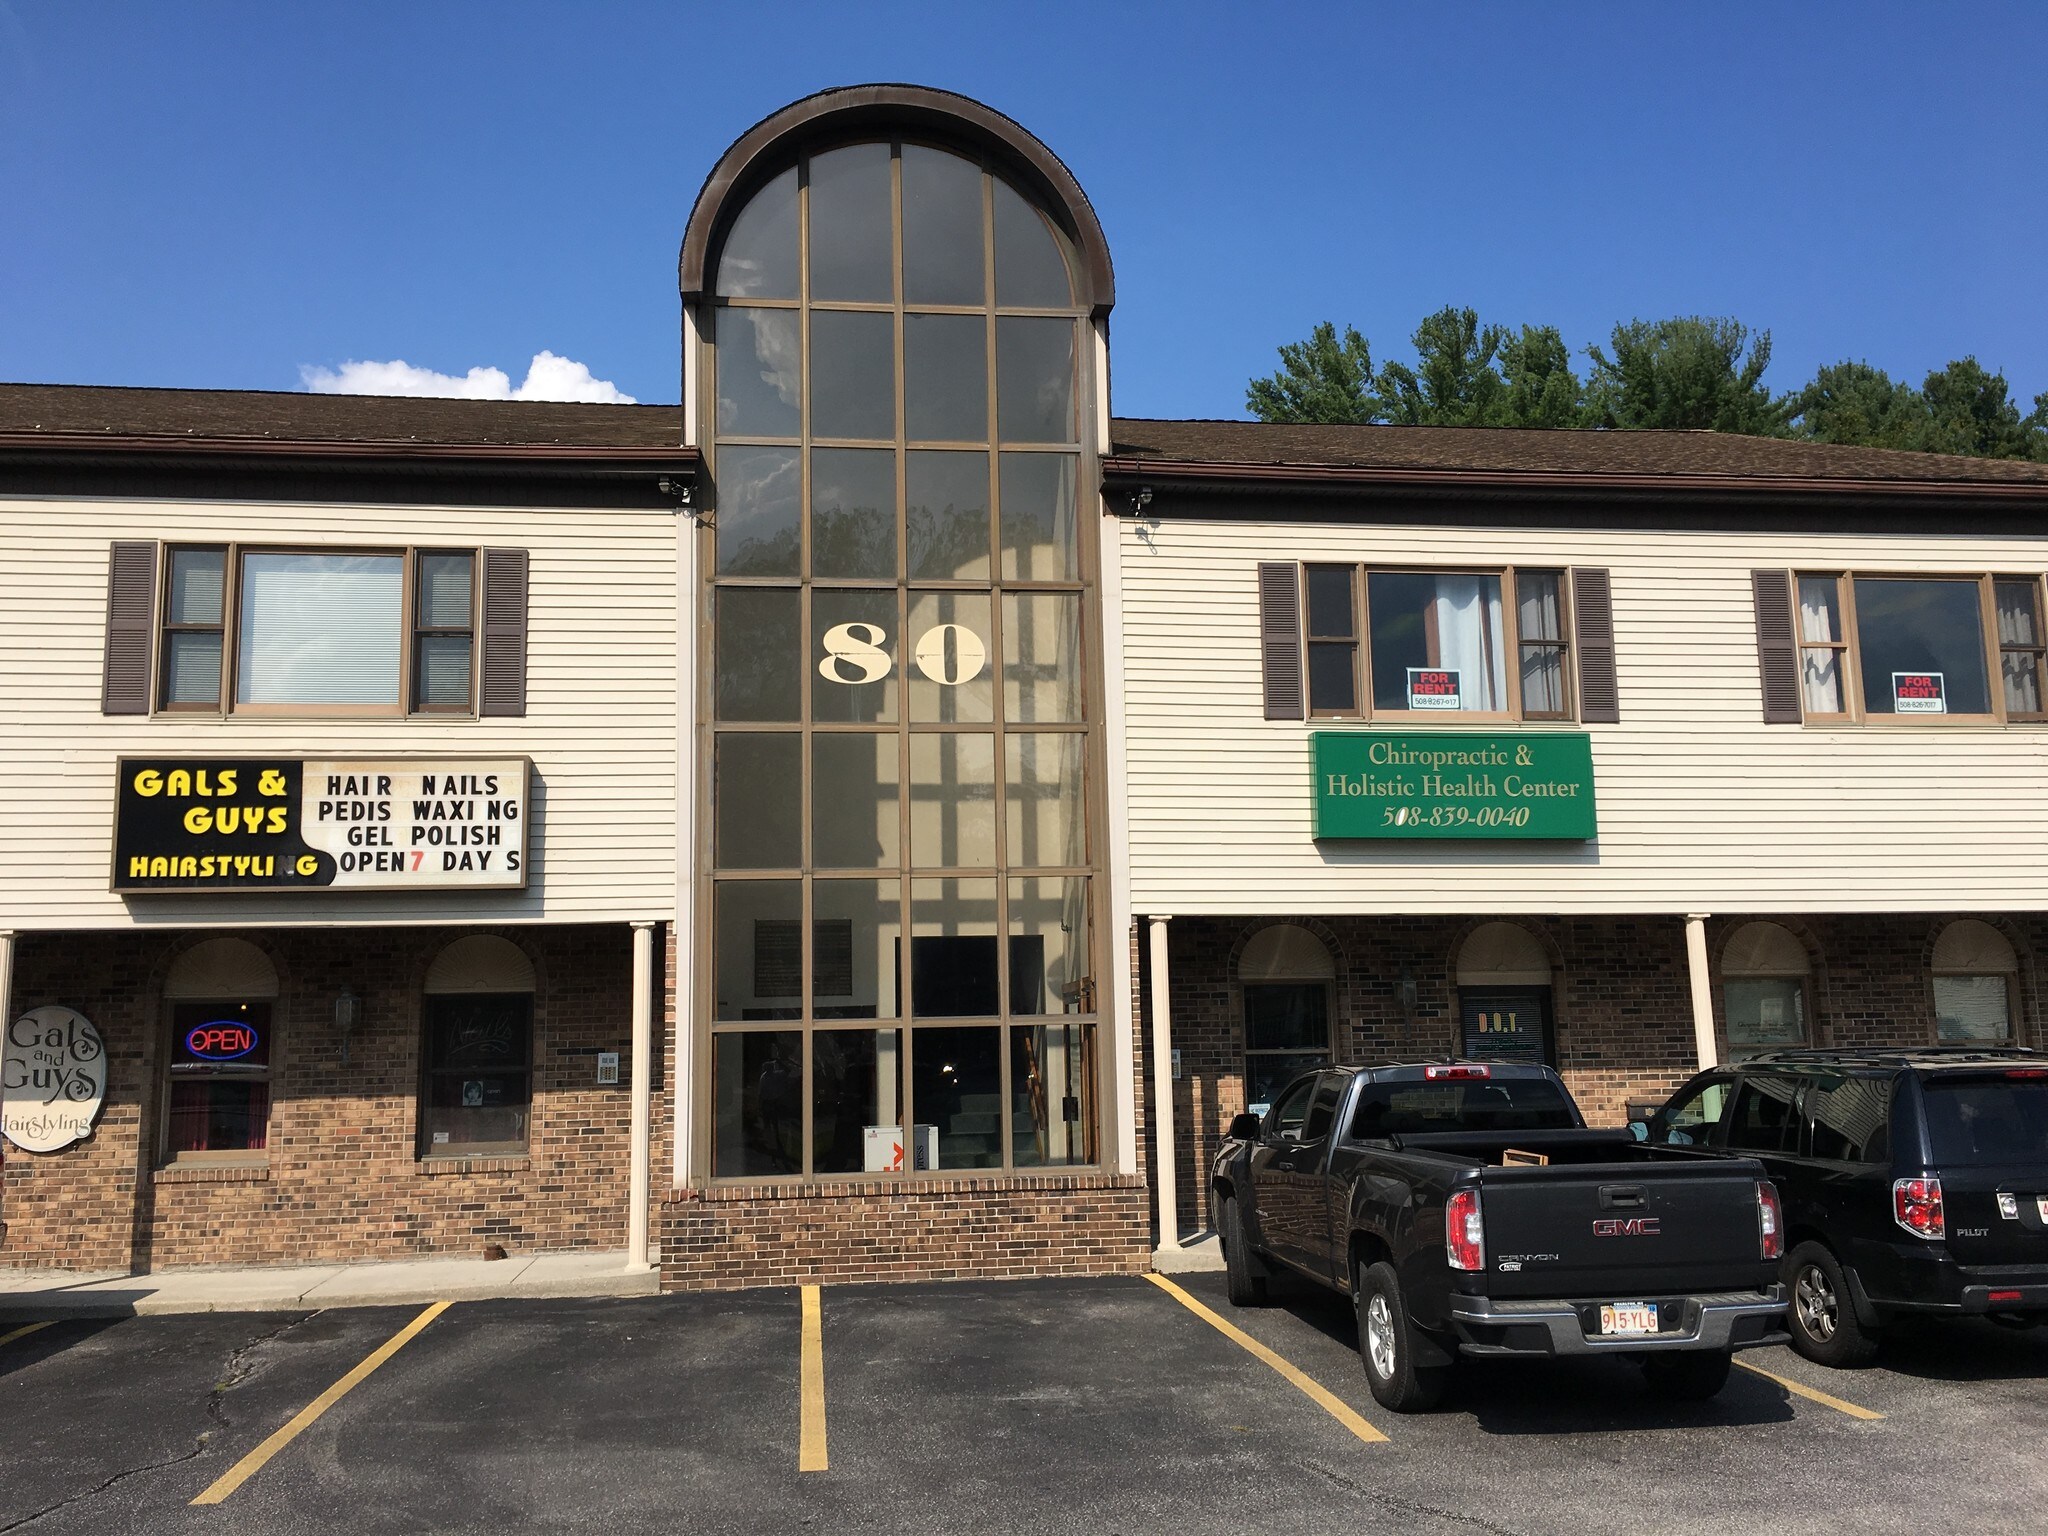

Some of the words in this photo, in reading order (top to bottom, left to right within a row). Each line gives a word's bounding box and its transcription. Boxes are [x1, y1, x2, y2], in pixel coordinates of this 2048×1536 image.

[819, 622, 986, 685] 80
[1413, 683, 1457, 694] RENT
[1420, 672, 1449, 684] FOR
[1905, 677, 1932, 686] FOR
[1898, 687, 1939, 697] RENT
[1369, 742, 1508, 772] Chiropractic
[1515, 744, 1534, 766] &
[134, 769, 239, 797] GALS
[258, 769, 288, 797] &
[327, 775, 391, 796] HAIR
[422, 775, 499, 796] NAILS
[1326, 774, 1415, 797] Holistic
[1421, 774, 1497, 797] Health
[1503, 775, 1580, 797] Center
[183, 806, 288, 835] GUYS
[318, 801, 391, 821] PEDIS
[412, 800, 518, 821] WAXING
[1380, 806, 1530, 827] 508-839-0040
[347, 827, 393, 847] GEL
[411, 825, 501, 847] POLISH
[128, 854, 319, 879] HAIRSTYLING
[340, 851, 405, 873] OPEN
[411, 851, 425, 872] 7
[9, 1018, 102, 1062] Gals
[190, 1029, 251, 1051] OPEN
[33, 1050, 65, 1067] and
[3, 1058, 97, 1106] Guys
[1593, 1218, 1661, 1237] GMC
[1956, 1228, 1990, 1237] PILOT
[1498, 1253, 1559, 1262] CANYON
